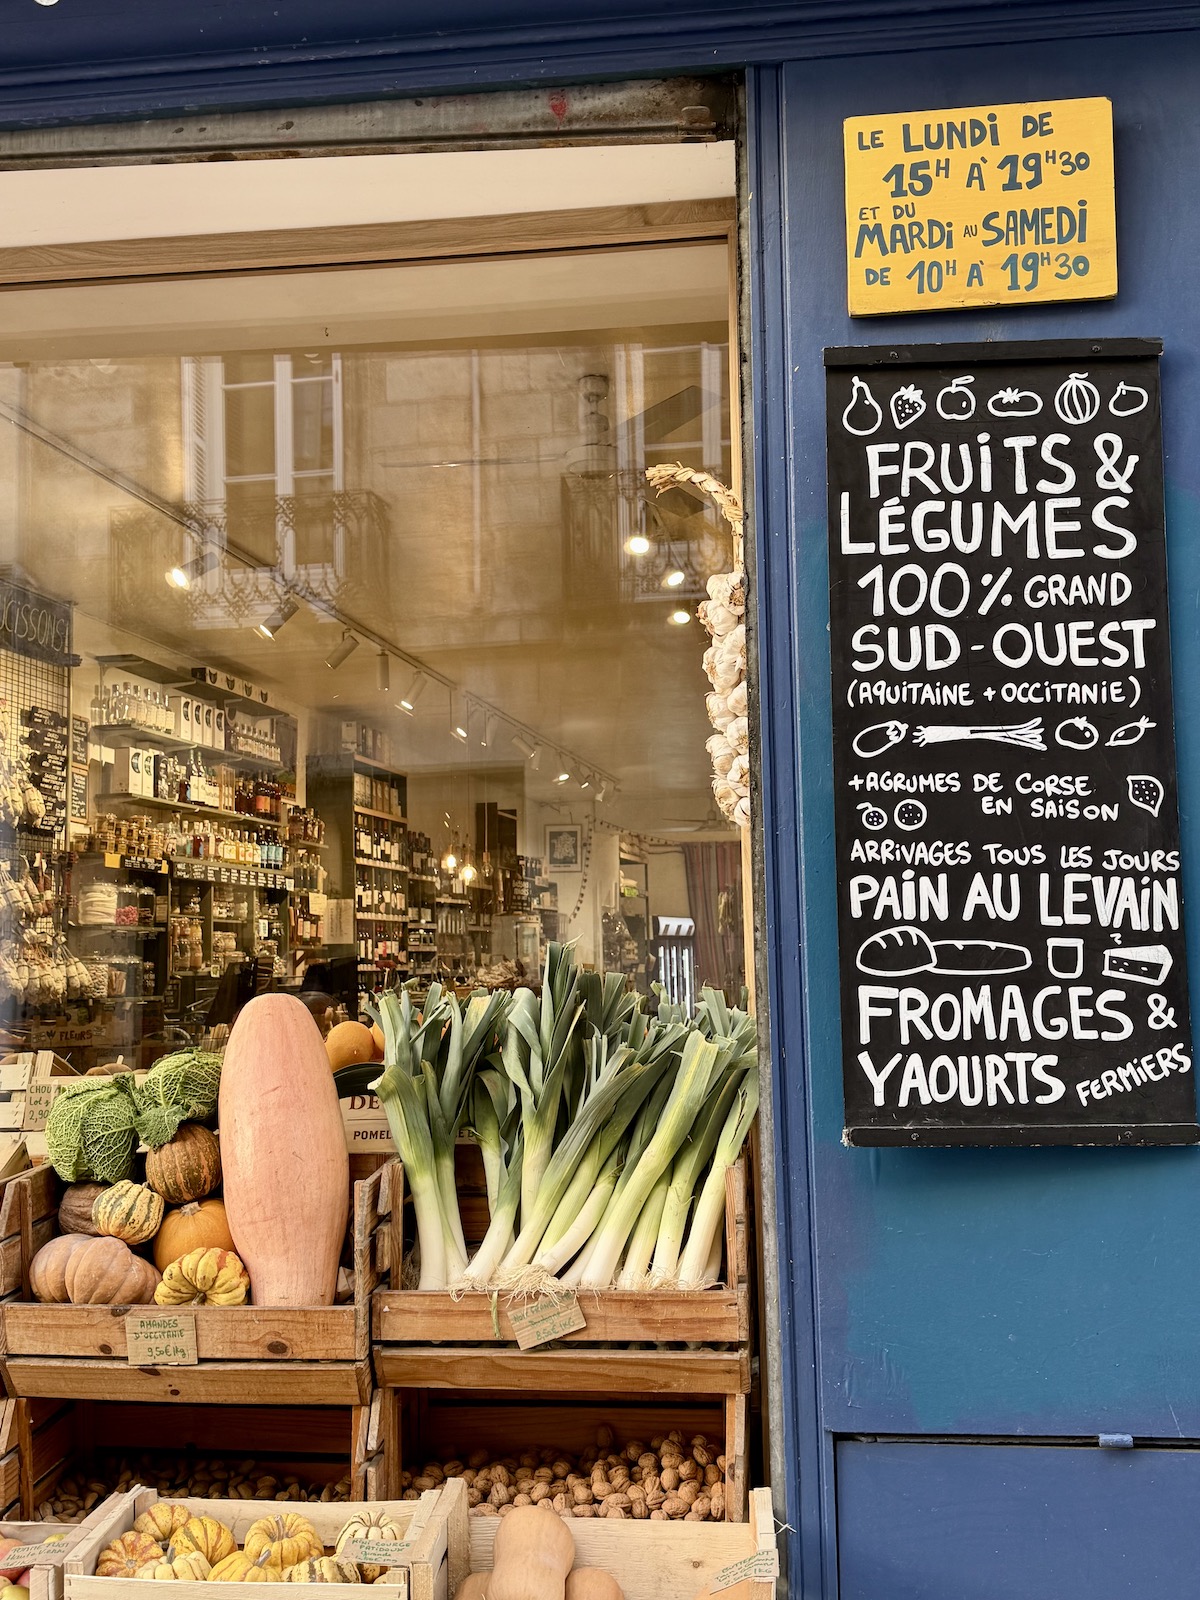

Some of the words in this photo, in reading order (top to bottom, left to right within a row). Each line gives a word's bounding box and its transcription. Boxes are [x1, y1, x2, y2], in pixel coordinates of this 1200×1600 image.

[858, 131, 883, 150] LE
[1023, 112, 1053, 138] DE
[966, 157, 987, 190] À
[859, 207, 879, 220] ET
[893, 203, 915, 219] DU
[964, 225, 977, 237] AU
[866, 268, 890, 285] DE
[967, 261, 983, 286] À
[1094, 433, 1139, 493] &
[841, 492, 1137, 559] LÉGUMES
[1024, 572, 1132, 608] GRAND
[983, 687, 996, 701] +
[973, 773, 1003, 792] DE
[982, 796, 1012, 815] EN
[982, 844, 1046, 865] TOUS
[1061, 846, 1092, 868] LES
[1102, 849, 1179, 872] JOURS
[963, 872, 1020, 921] AU
[858, 985, 1133, 1045] FROMAGES
[1147, 993, 1177, 1029] &
[29, 1085, 52, 1094] CHOU
[858, 1051, 1066, 1107] YAOURTS
[140, 1319, 178, 1328] AMANDES
